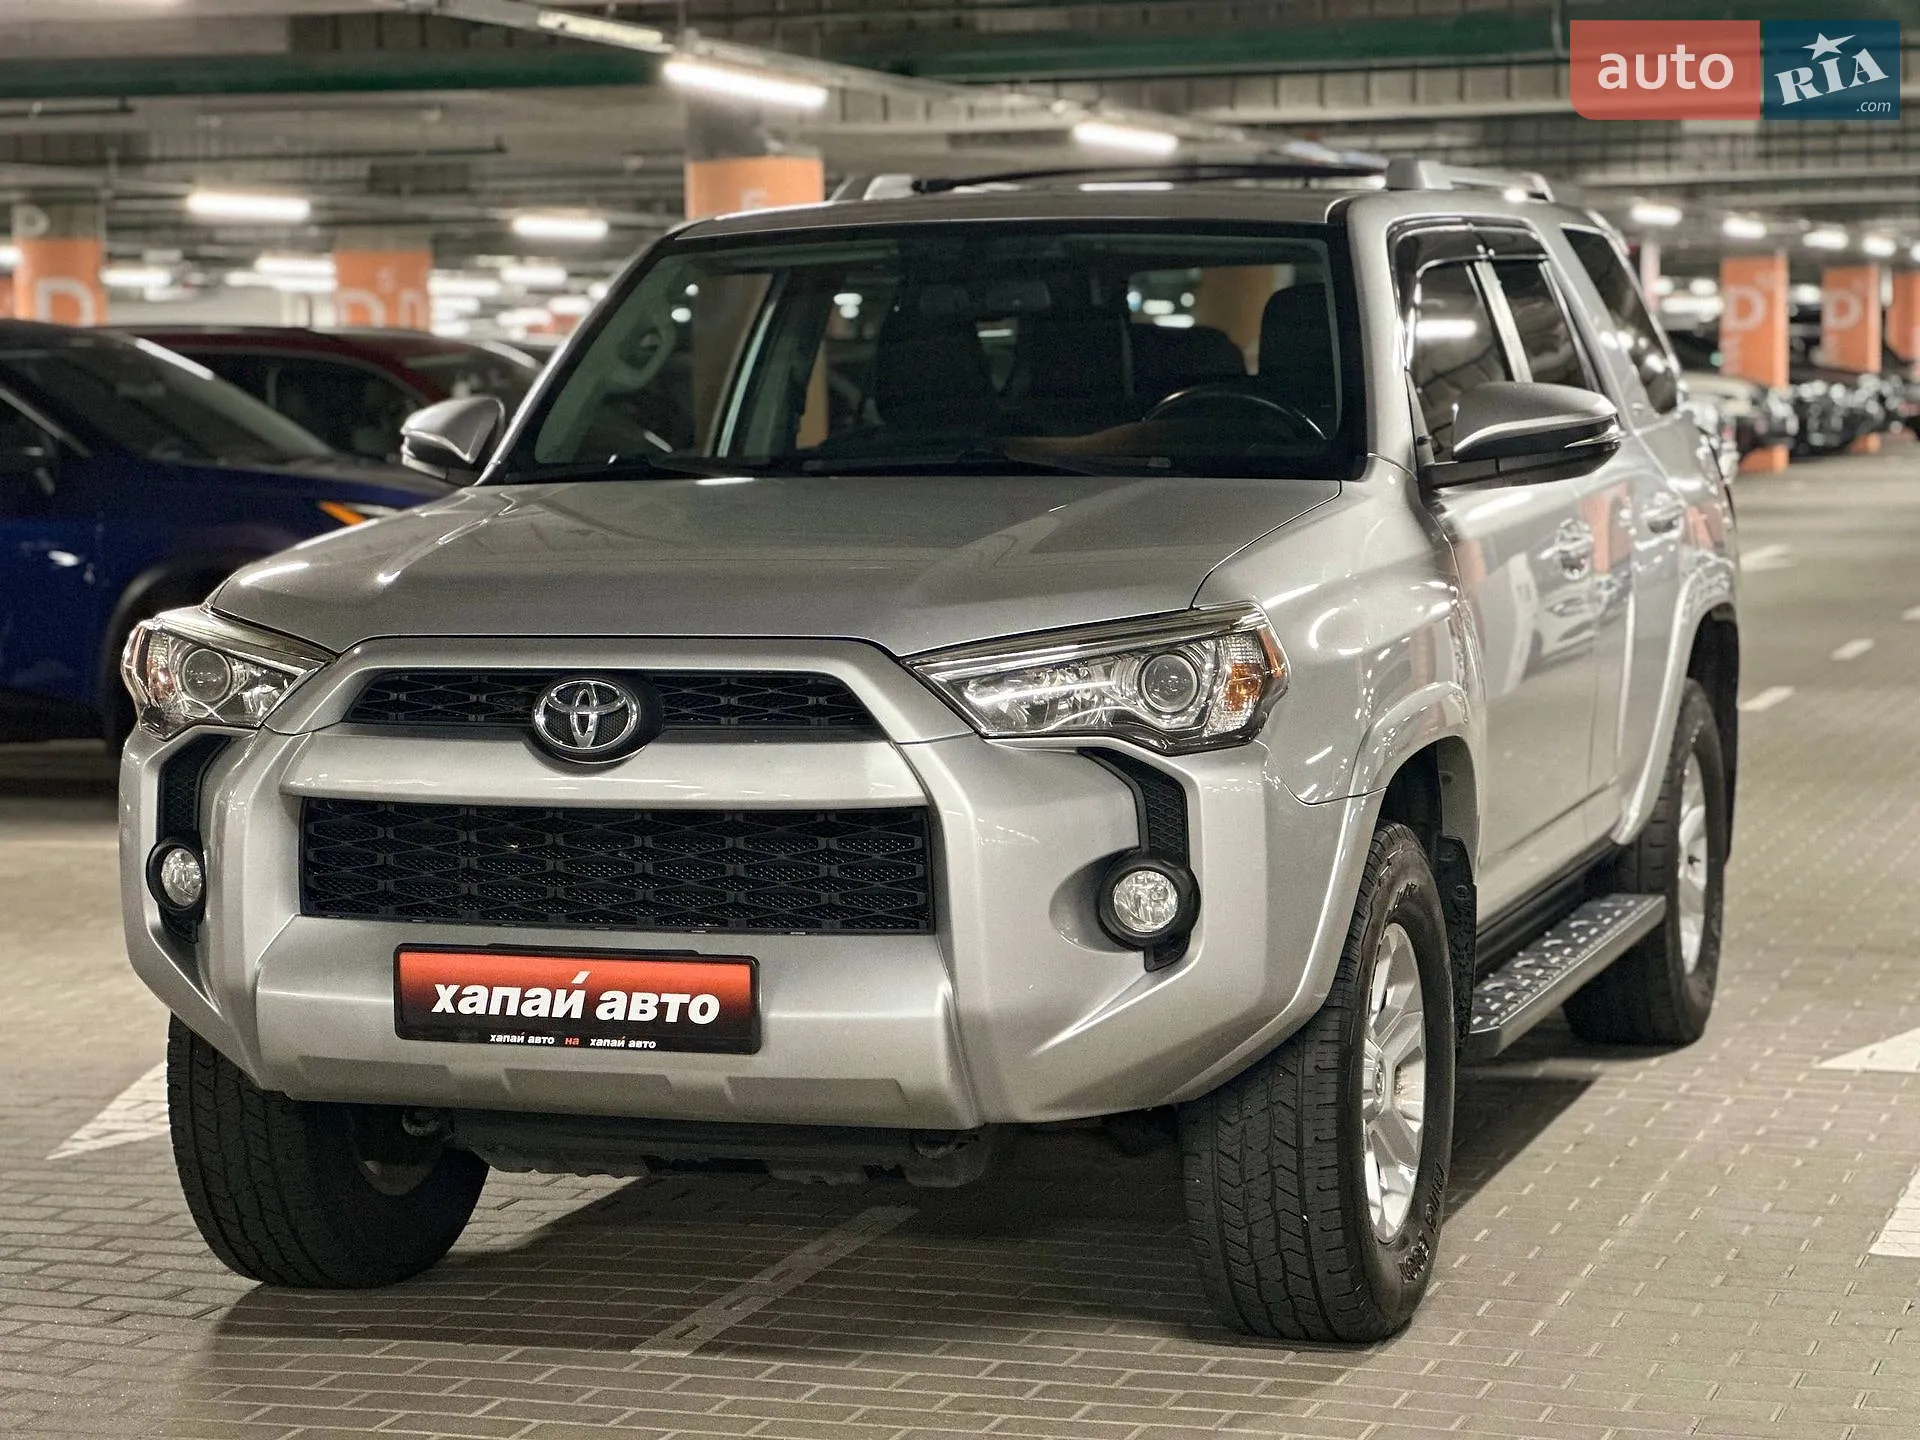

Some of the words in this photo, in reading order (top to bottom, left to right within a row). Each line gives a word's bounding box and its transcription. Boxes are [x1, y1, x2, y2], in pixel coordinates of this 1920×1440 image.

[595, 990, 721, 1025] авто
[527, 1035, 555, 1046] авто
[564, 1037, 580, 1047] на
[627, 1041, 657, 1050] авто
